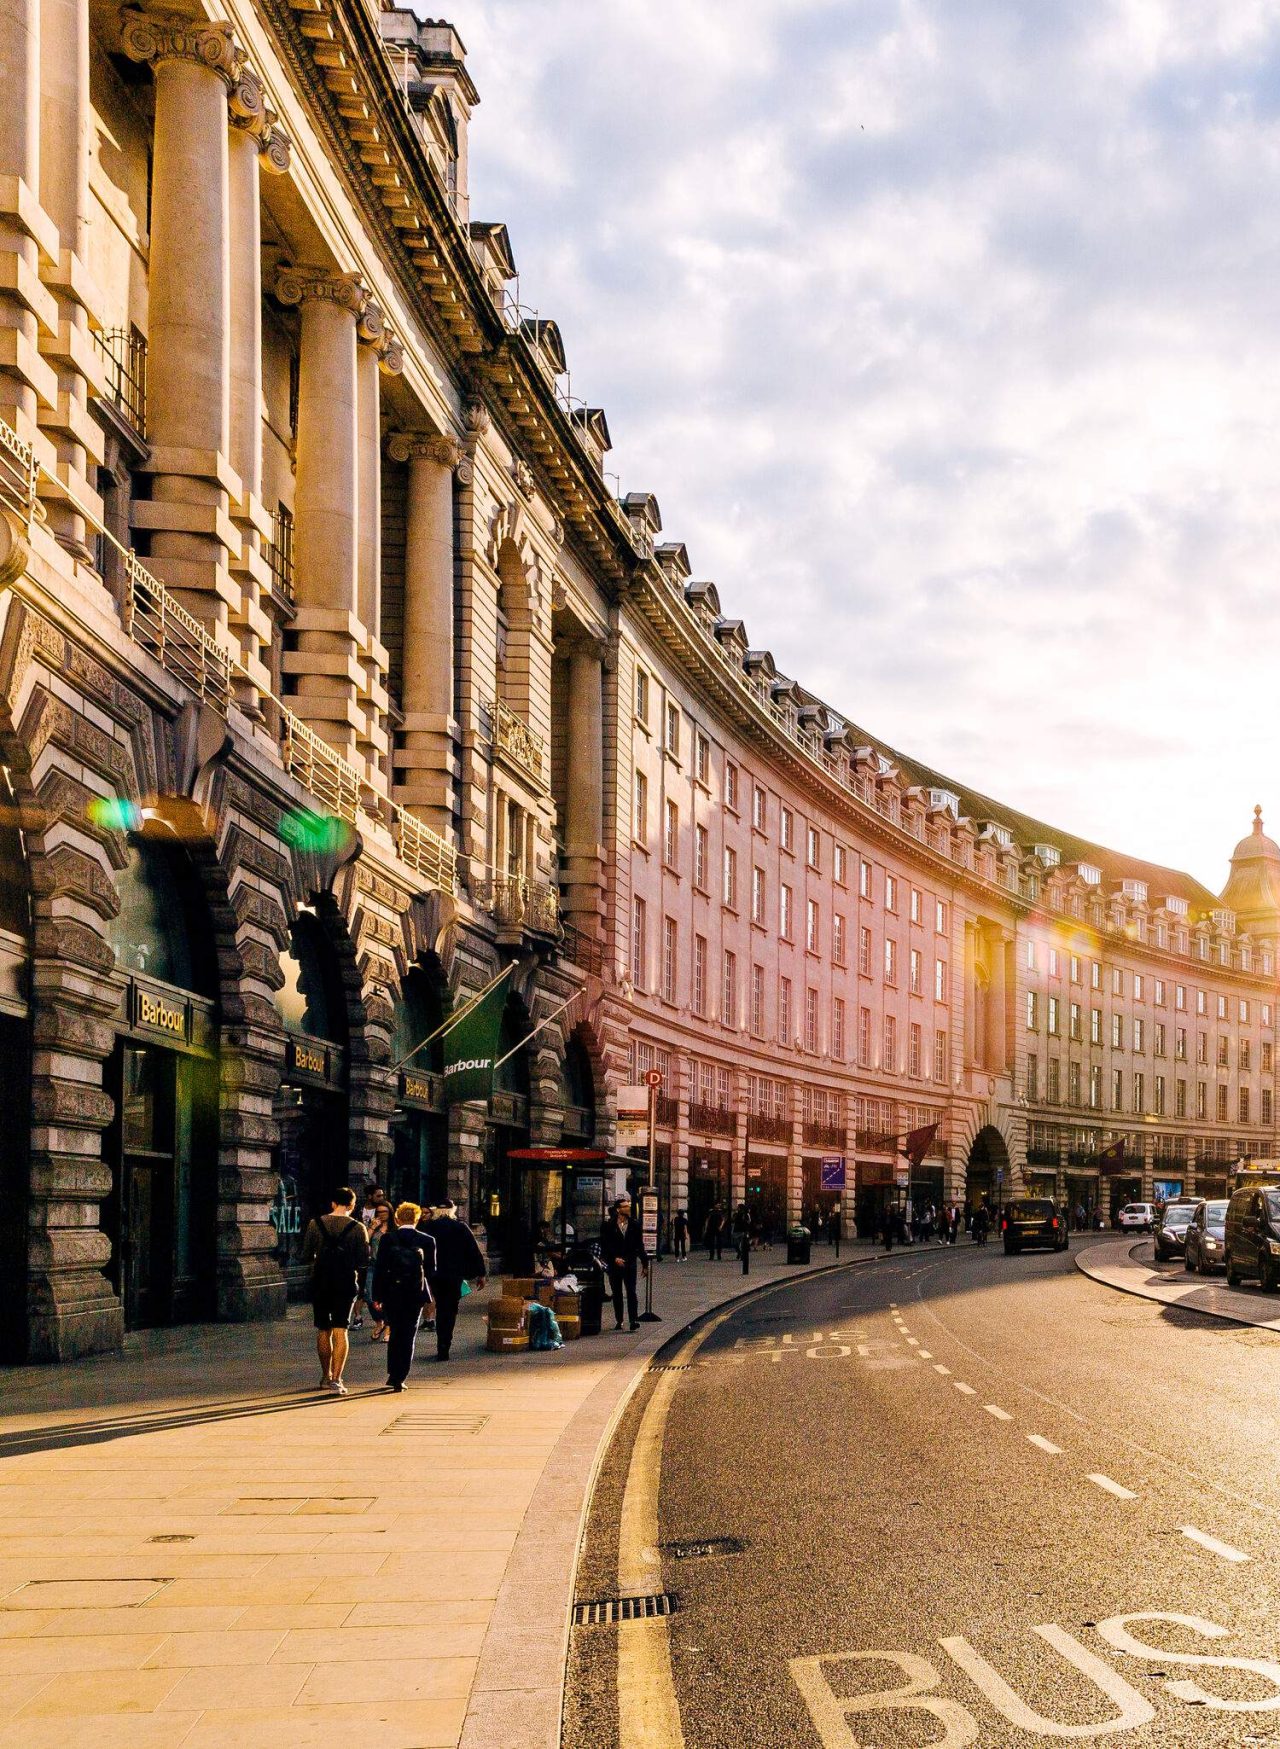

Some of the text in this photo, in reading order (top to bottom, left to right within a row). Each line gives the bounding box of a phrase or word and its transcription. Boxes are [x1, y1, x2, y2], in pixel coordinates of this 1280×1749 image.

[141, 993, 185, 1032] Barbour
[295, 1046, 325, 1073] Barbour
[405, 1076, 429, 1099] Barbour
[649, 1072, 660, 1084] D
[734, 1330, 869, 1349] BUS
